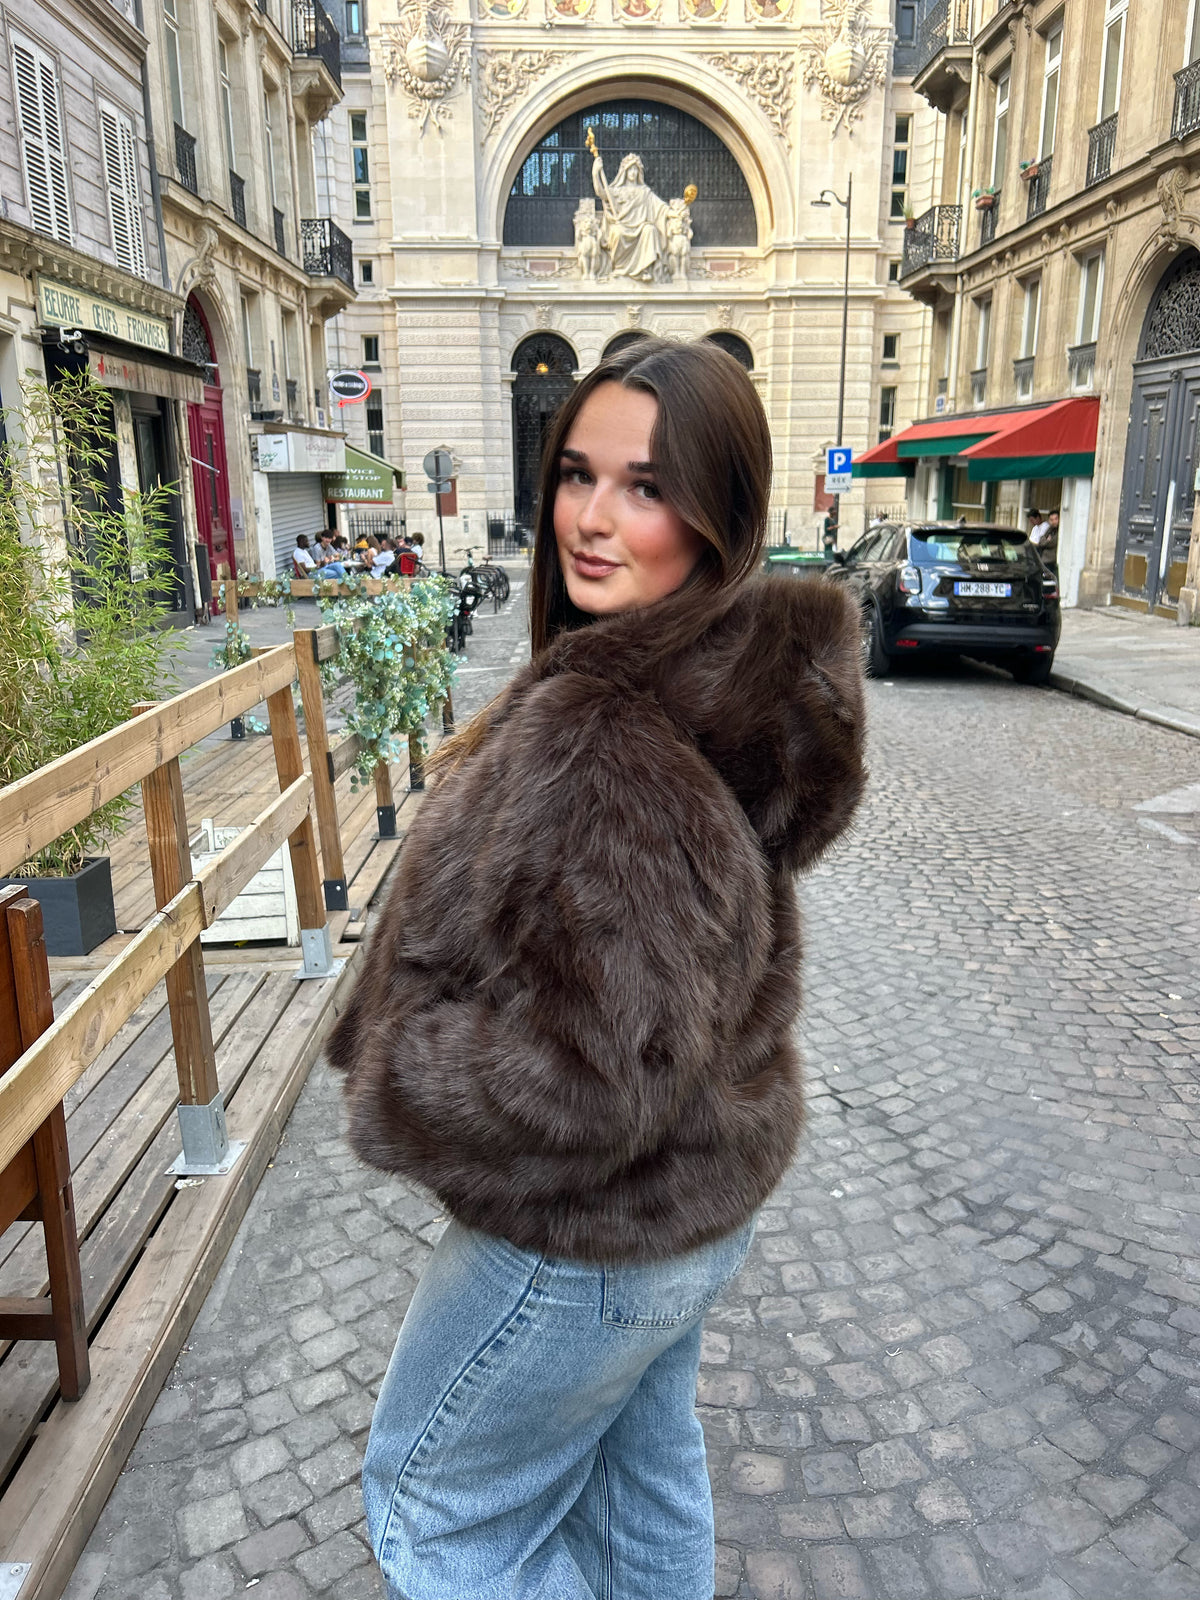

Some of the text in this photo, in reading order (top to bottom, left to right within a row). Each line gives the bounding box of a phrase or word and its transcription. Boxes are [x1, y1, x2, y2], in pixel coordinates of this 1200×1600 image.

[43, 286, 166, 350] BEURRE ŒUFS FROMAGES
[833, 452, 846, 470] P
[327, 488, 384, 499] RESTAURANT
